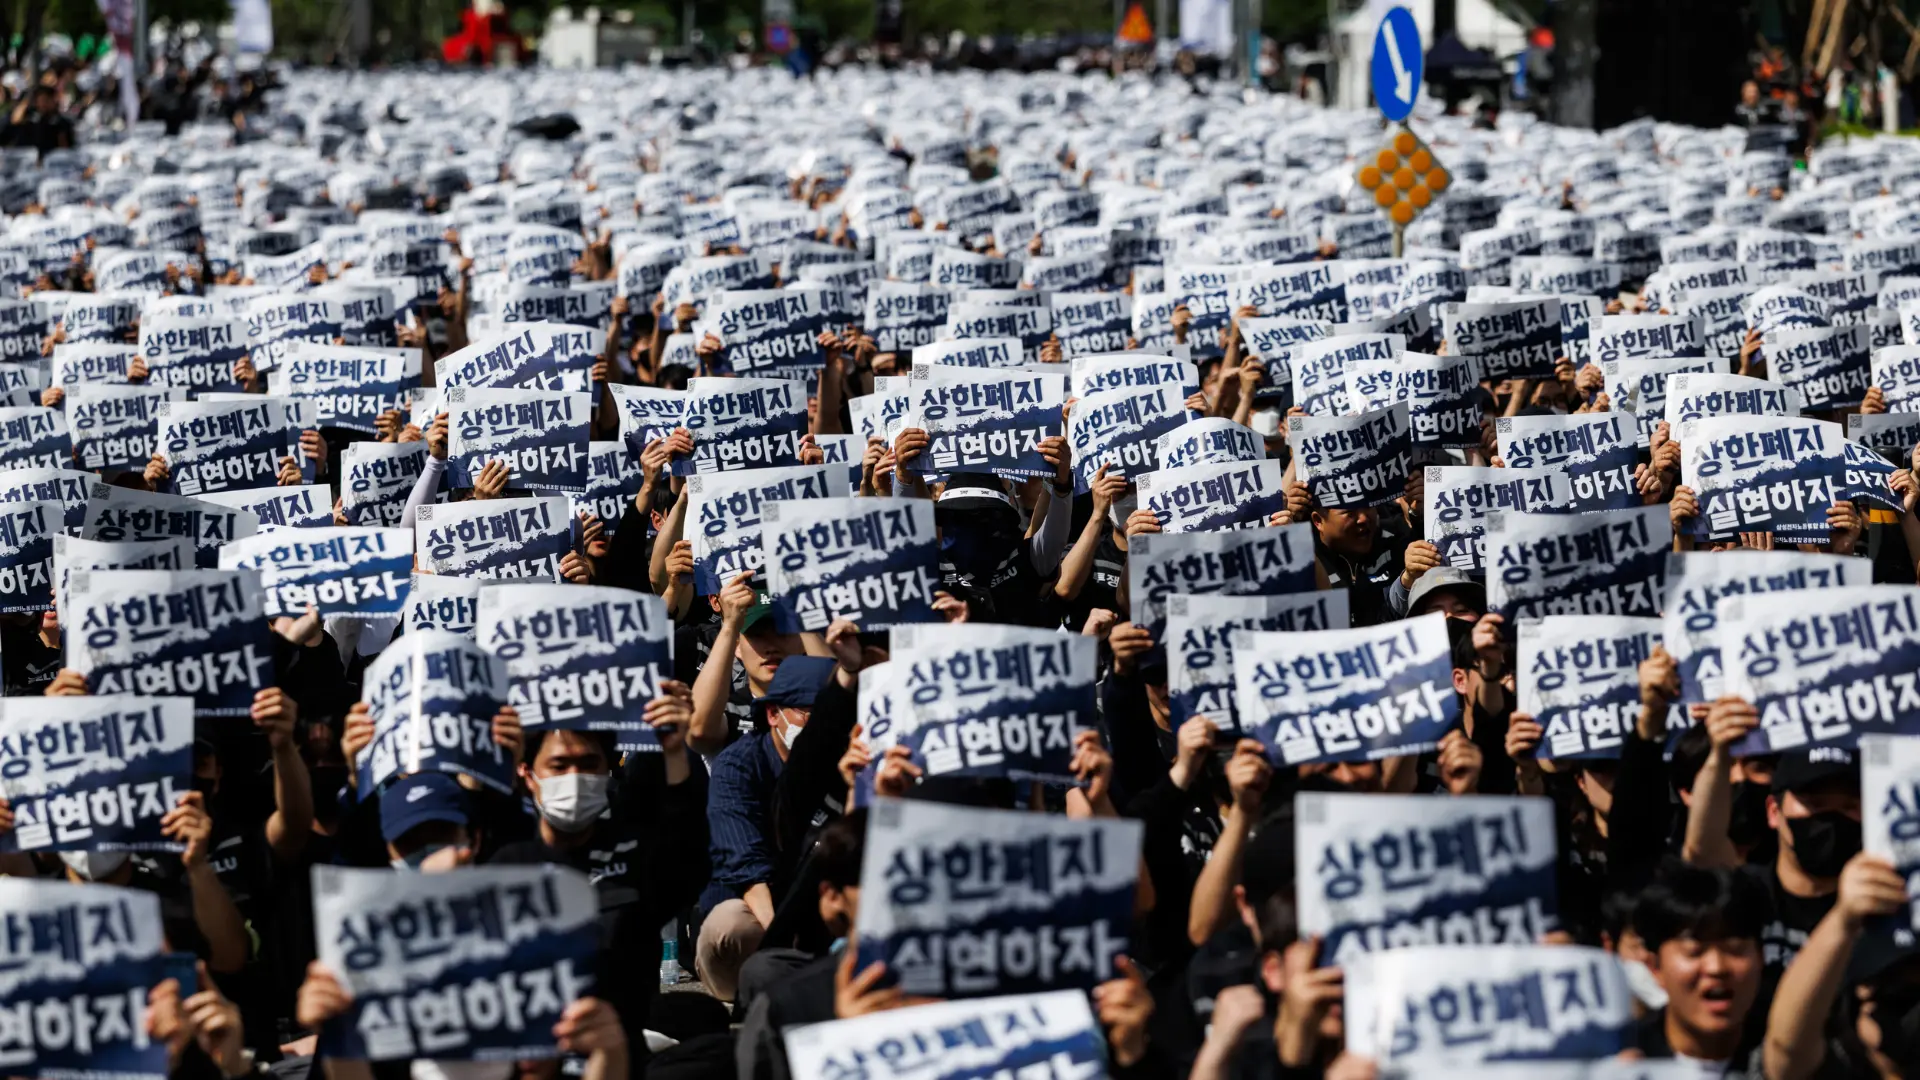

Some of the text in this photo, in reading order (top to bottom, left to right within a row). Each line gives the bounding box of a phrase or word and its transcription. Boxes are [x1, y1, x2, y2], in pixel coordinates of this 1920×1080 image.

[0, 301, 37, 323] 폐지
[342, 296, 386, 323] 폐지
[501, 294, 588, 323] 상한폐지
[719, 291, 810, 335] 상한폐지
[873, 291, 953, 320] 상한폐지
[1248, 264, 1331, 309] 상한폐지
[1804, 275, 1866, 308] 한폐지
[144, 322, 233, 357] 상한폐지
[247, 300, 330, 337] 상한폐지
[1453, 303, 1547, 346] 상한폐지
[1598, 321, 1697, 362] 상한폐지
[287, 358, 386, 384] 상한폐지
[728, 331, 820, 371] 실현하자
[1298, 337, 1394, 390] 상한폐지
[1774, 328, 1859, 375] 상한폐지
[681, 382, 794, 431] 상한폐지
[918, 380, 1043, 422] 상한폐지
[1395, 359, 1473, 402] 상한폐지
[164, 402, 275, 452] 상한폐지
[456, 396, 575, 441] 상한폐지
[1072, 387, 1167, 451] 상한폐지
[1299, 406, 1401, 459] 상한폐지
[349, 446, 430, 494] 상한폐
[692, 427, 806, 473] 실현하자
[929, 424, 1050, 467] 실현하자
[1690, 423, 1825, 480] 상한폐지
[175, 452, 288, 496] 실현하자
[1148, 462, 1266, 527] 상한폐지
[1313, 450, 1415, 509] 실현하자
[1432, 474, 1555, 525] 상한폐지
[1704, 475, 1848, 533] 실현하자
[425, 500, 552, 562] 상한폐지
[774, 504, 919, 574] 상한폐지
[1496, 511, 1650, 586] 상한폐지
[82, 574, 245, 649] 상한폐지
[794, 565, 939, 633] 실현하자
[490, 599, 651, 657] 상한폐지
[1738, 593, 1920, 680] 상한폐지
[903, 638, 1072, 706] 상한폐지
[1250, 627, 1422, 700] 상한폐지
[507, 661, 664, 727] 실현하자
[0, 703, 164, 780] 상한폐지
[919, 709, 1087, 776] 실현하자
[1275, 678, 1456, 766] 실현하자
[14, 775, 192, 851] 실현하자
[881, 825, 1107, 908] 상한폐지
[1315, 803, 1532, 900] 상한폐지
[335, 873, 562, 972] 상한폐지
[888, 917, 1129, 997] 실현하자
[354, 956, 596, 1060] 실현하자
